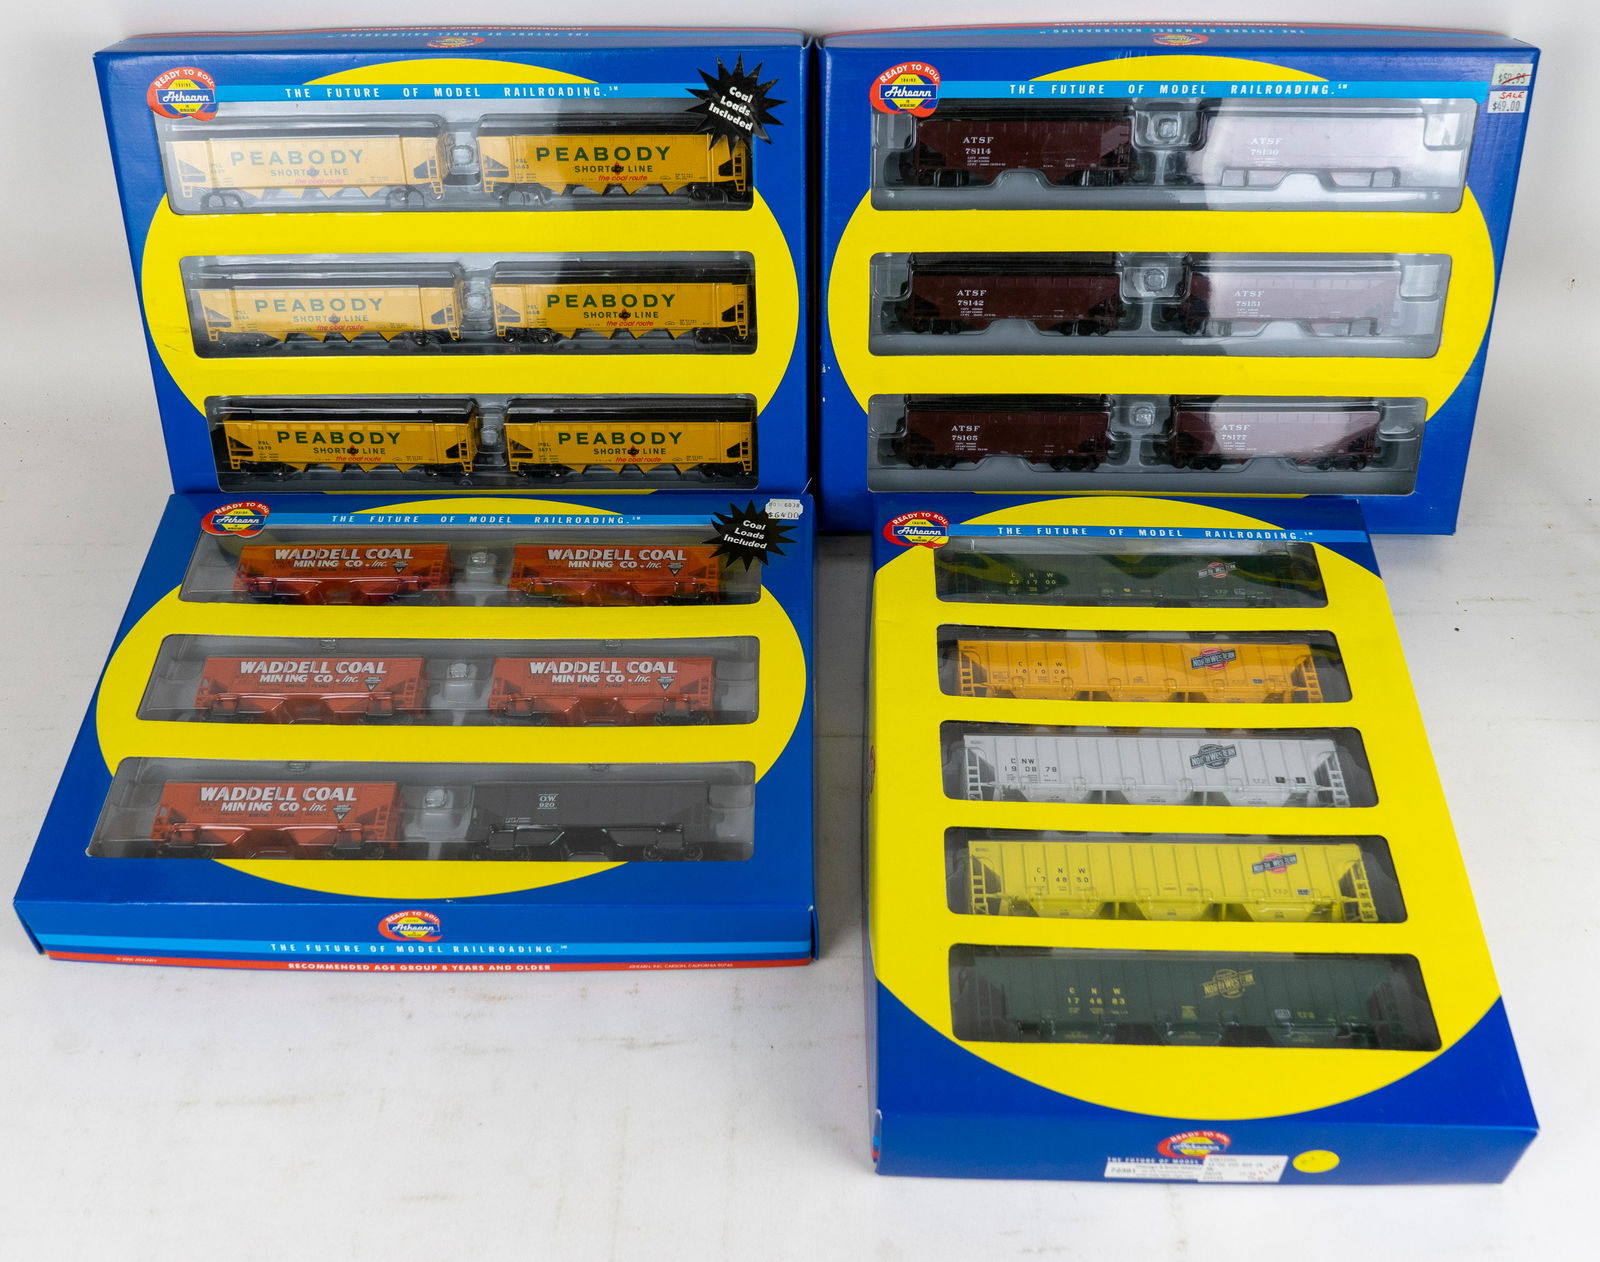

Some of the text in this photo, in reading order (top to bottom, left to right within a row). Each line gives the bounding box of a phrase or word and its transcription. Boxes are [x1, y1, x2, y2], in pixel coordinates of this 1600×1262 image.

[154, 69, 180, 88] READY
[197, 71, 215, 87] ROLL
[880, 65, 907, 83] READY
[925, 66, 939, 81] ROLL
[285, 88, 311, 98] THE
[327, 88, 380, 98] FUTURE
[403, 87, 419, 97] OF
[434, 86, 480, 97] MODEL
[729, 86, 753, 103] Coal
[884, 86, 932, 97] Athearn
[1010, 84, 1035, 94] THE
[1051, 84, 1105, 94] FUTURE
[1128, 84, 1145, 94] OF
[1160, 84, 1207, 95] MODEL
[1499, 91, 1525, 99] SALE
[163, 91, 210, 102] Athearn
[720, 95, 751, 116] Loads
[708, 103, 753, 131] Included
[1250, 137, 1282, 145] ATSF
[230, 150, 364, 165] PEABODY
[536, 146, 671, 162] PEABODY
[270, 168, 349, 177] SHORT LINE
[574, 165, 612, 173] SHORT
[255, 298, 383, 313] PEABODY
[547, 294, 675, 308] PEABODY
[344, 314, 368, 322] LINE
[583, 311, 659, 319] SHORT LINE
[277, 431, 401, 444] PEABODY
[558, 432, 682, 444] PEABODY
[215, 503, 243, 514] READY
[257, 503, 270, 513] ROLL
[743, 519, 766, 531] Coal
[892, 513, 918, 525] READY
[933, 514, 948, 524] ROLL
[734, 527, 765, 540] Loads
[897, 527, 941, 535] Athearn
[998, 527, 1021, 535] THE
[1037, 527, 1087, 535] FUTURE
[1109, 528, 1124, 536] OF
[1138, 529, 1183, 537] MODEL
[723, 534, 768, 550] Included
[275, 549, 414, 560] WADDELL COAL
[547, 549, 687, 561] WADDELL COAL
[293, 560, 339, 568] MINING
[240, 661, 387, 674] WADDELL COAL
[529, 661, 678, 674] WADDELL COAL
[259, 674, 308, 683] MINING
[551, 674, 600, 683] MINING
[200, 787, 357, 801] WADDELL COAL
[221, 802, 273, 811] MINING
[385, 911, 409, 922] READY
[271, 943, 296, 951] THE
[306, 944, 360, 952] FUTURE
[370, 945, 385, 953] OF
[397, 945, 443, 953] MODEL
